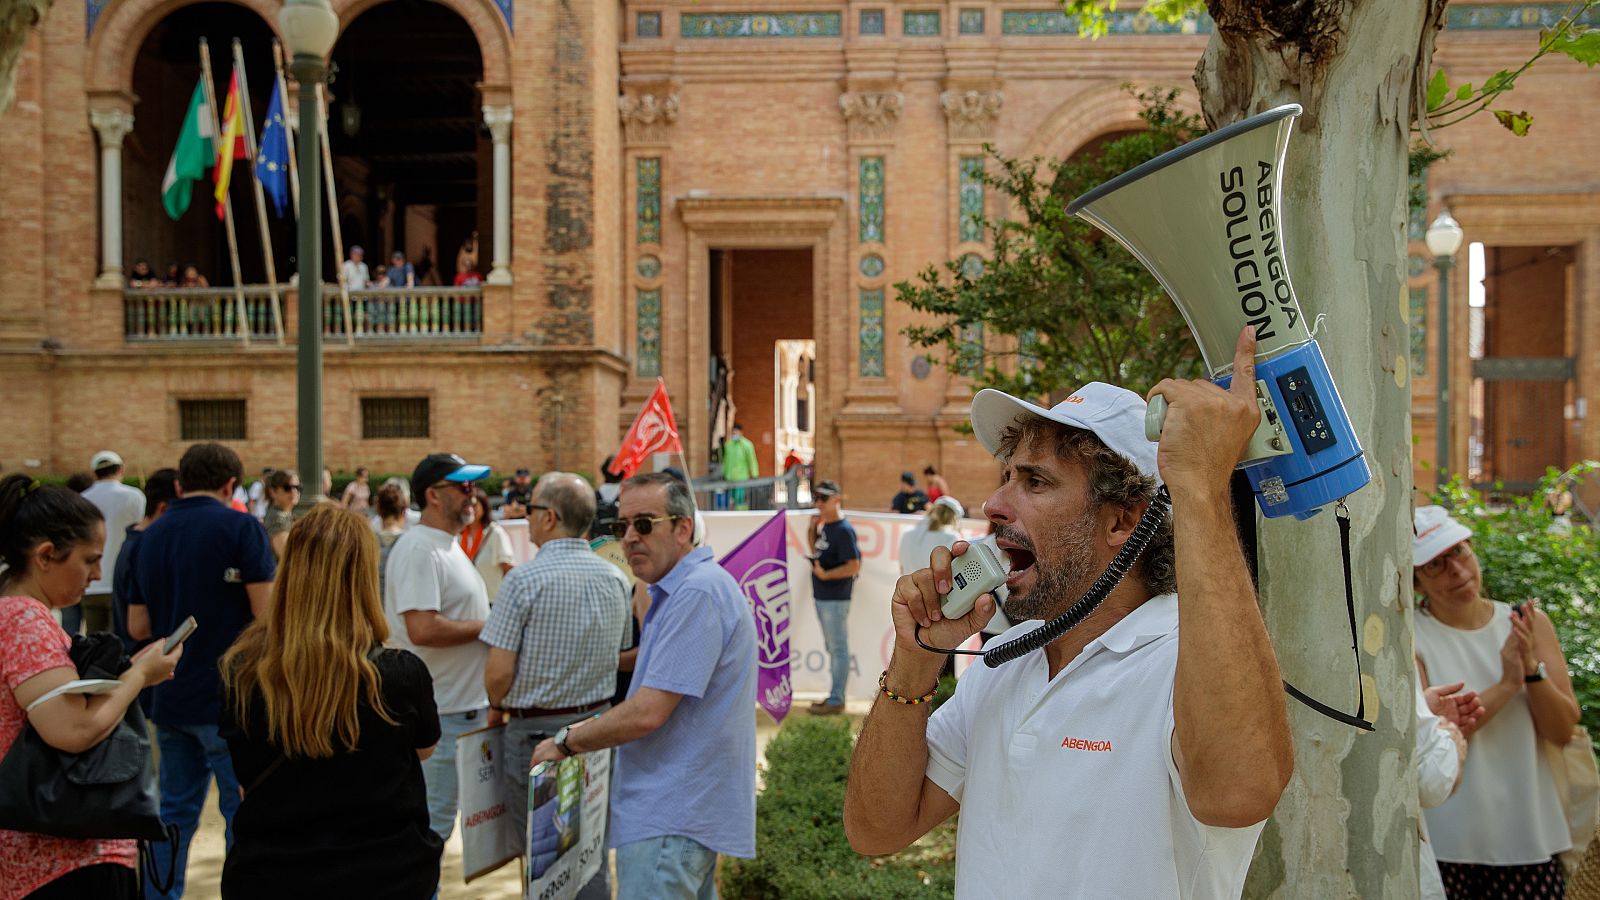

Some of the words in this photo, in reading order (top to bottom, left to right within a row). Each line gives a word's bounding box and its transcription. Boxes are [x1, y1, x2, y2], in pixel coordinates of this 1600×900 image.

[1220, 166, 1276, 341] SOLUCIÓN
[1257, 160, 1299, 329] ABENGOA
[1061, 736, 1112, 752] ABENGOA
